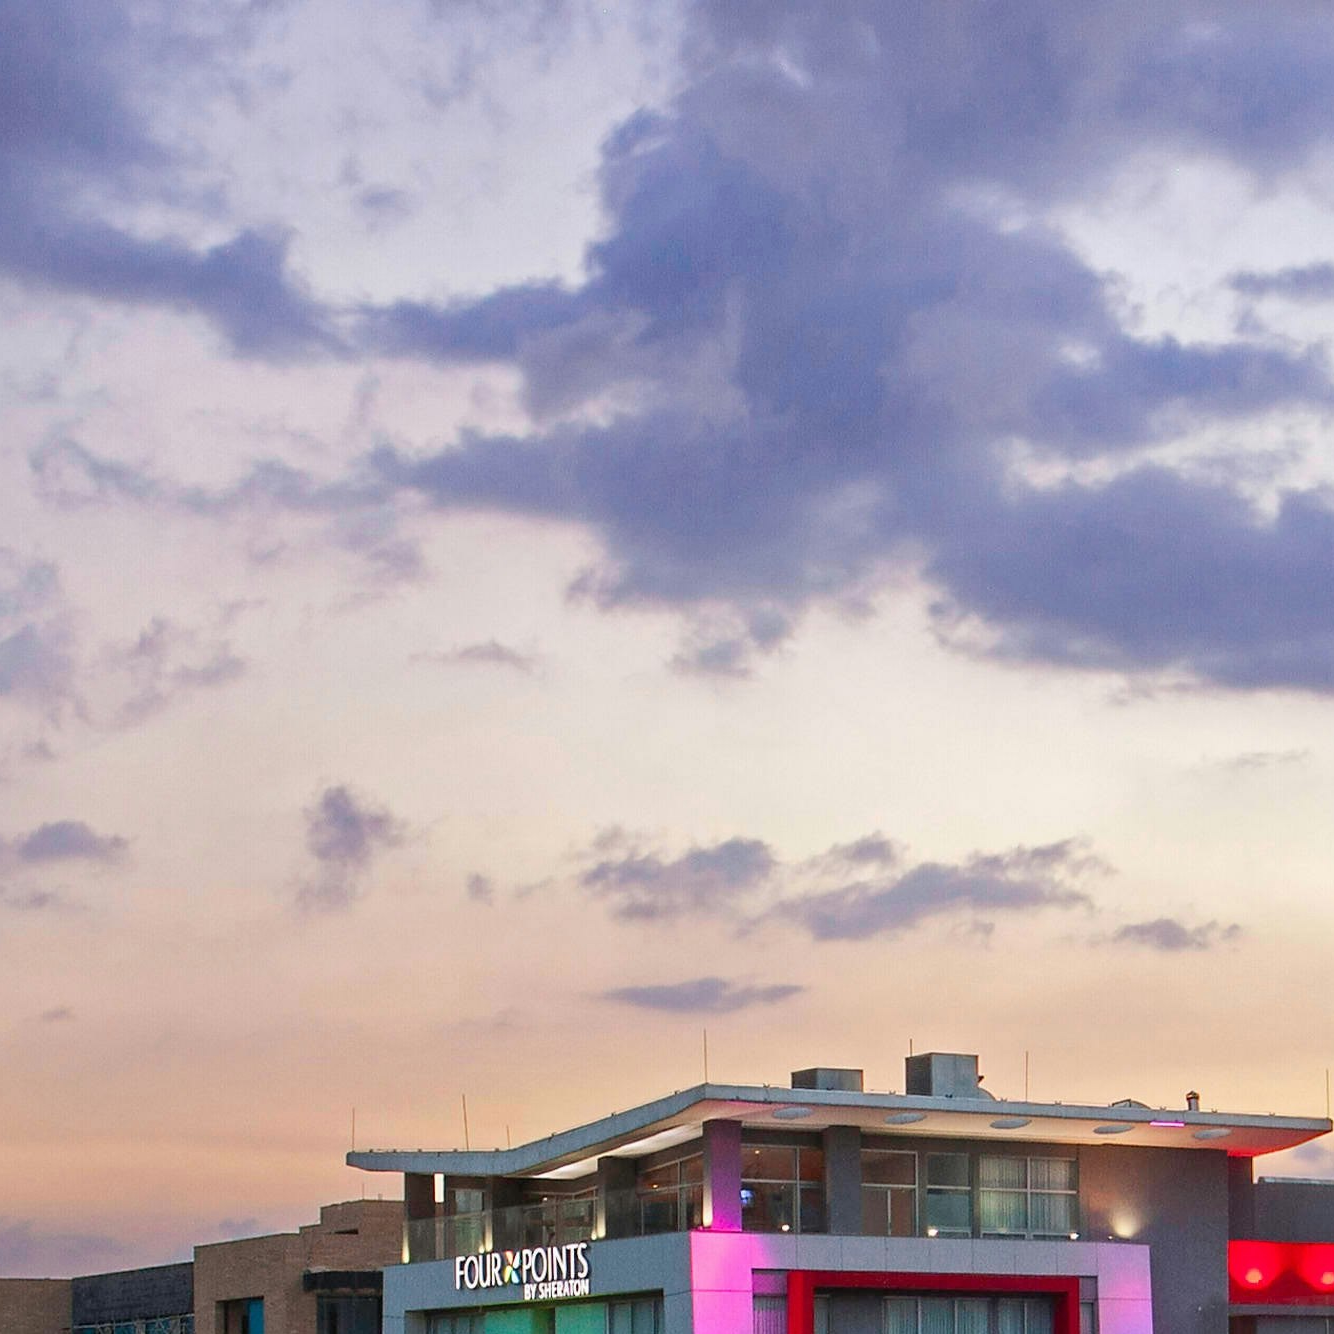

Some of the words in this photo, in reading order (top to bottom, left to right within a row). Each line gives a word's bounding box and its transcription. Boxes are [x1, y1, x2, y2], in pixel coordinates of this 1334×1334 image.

[455, 1253, 503, 1290] FOUR
[522, 1243, 589, 1283] POINTS
[524, 1283, 537, 1300] BY
[538, 1279, 589, 1299] SHERATON
